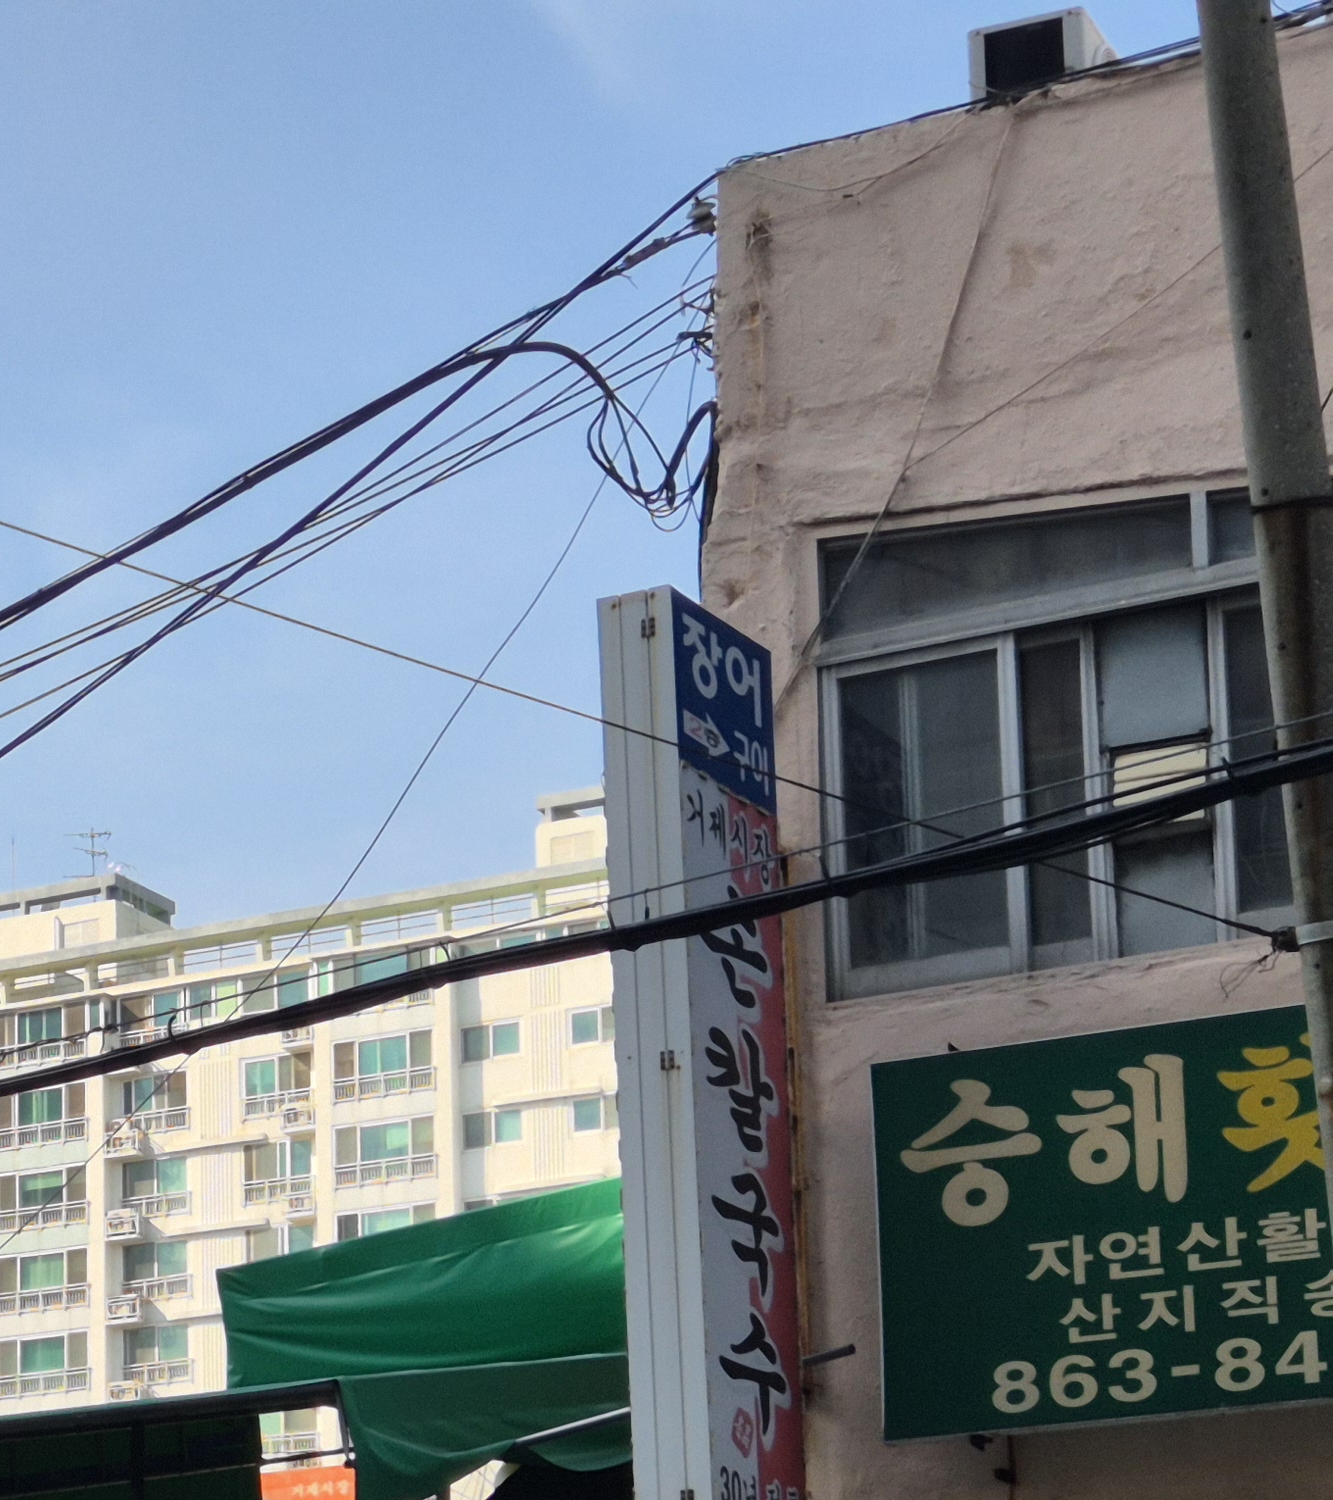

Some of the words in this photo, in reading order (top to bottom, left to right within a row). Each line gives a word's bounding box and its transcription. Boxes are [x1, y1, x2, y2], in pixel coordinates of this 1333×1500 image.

[681, 613, 763, 729] 장어
[733, 729, 770, 797] 구이
[686, 788, 776, 887] 거제시장
[899, 1053, 1189, 1228] 승해
[1025, 1207, 1327, 1286] 자연산활
